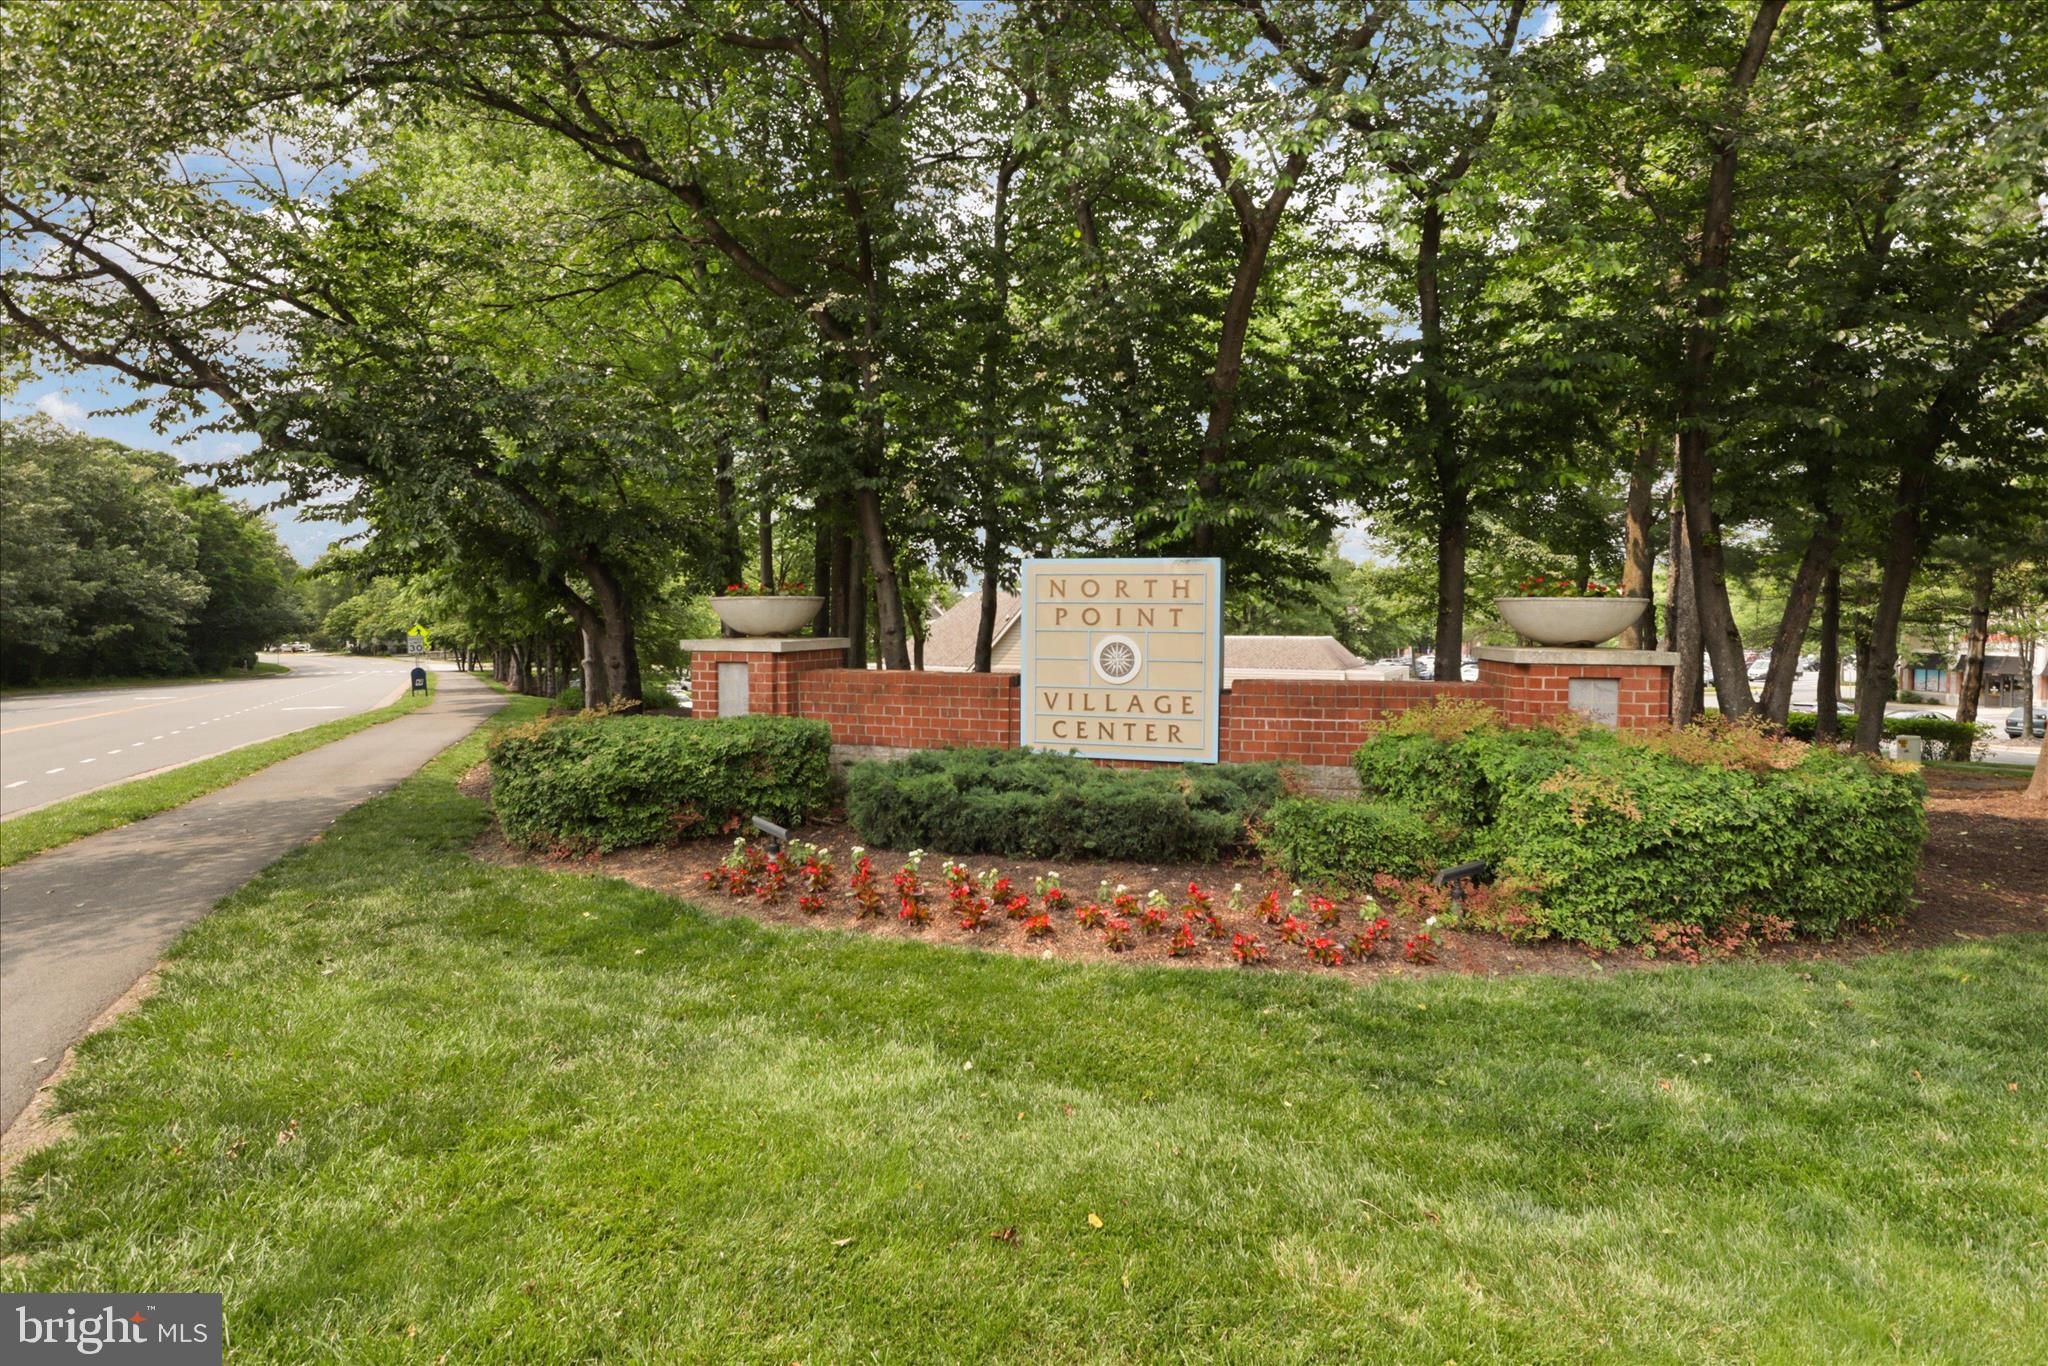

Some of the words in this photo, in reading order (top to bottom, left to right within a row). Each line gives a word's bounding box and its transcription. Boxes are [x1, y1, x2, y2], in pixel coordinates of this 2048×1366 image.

[1049, 579, 1190, 598] NORTH
[1055, 607, 1183, 626] POINT
[1044, 692, 1194, 714] VILLAGE
[1052, 720, 1183, 743] CENTER
